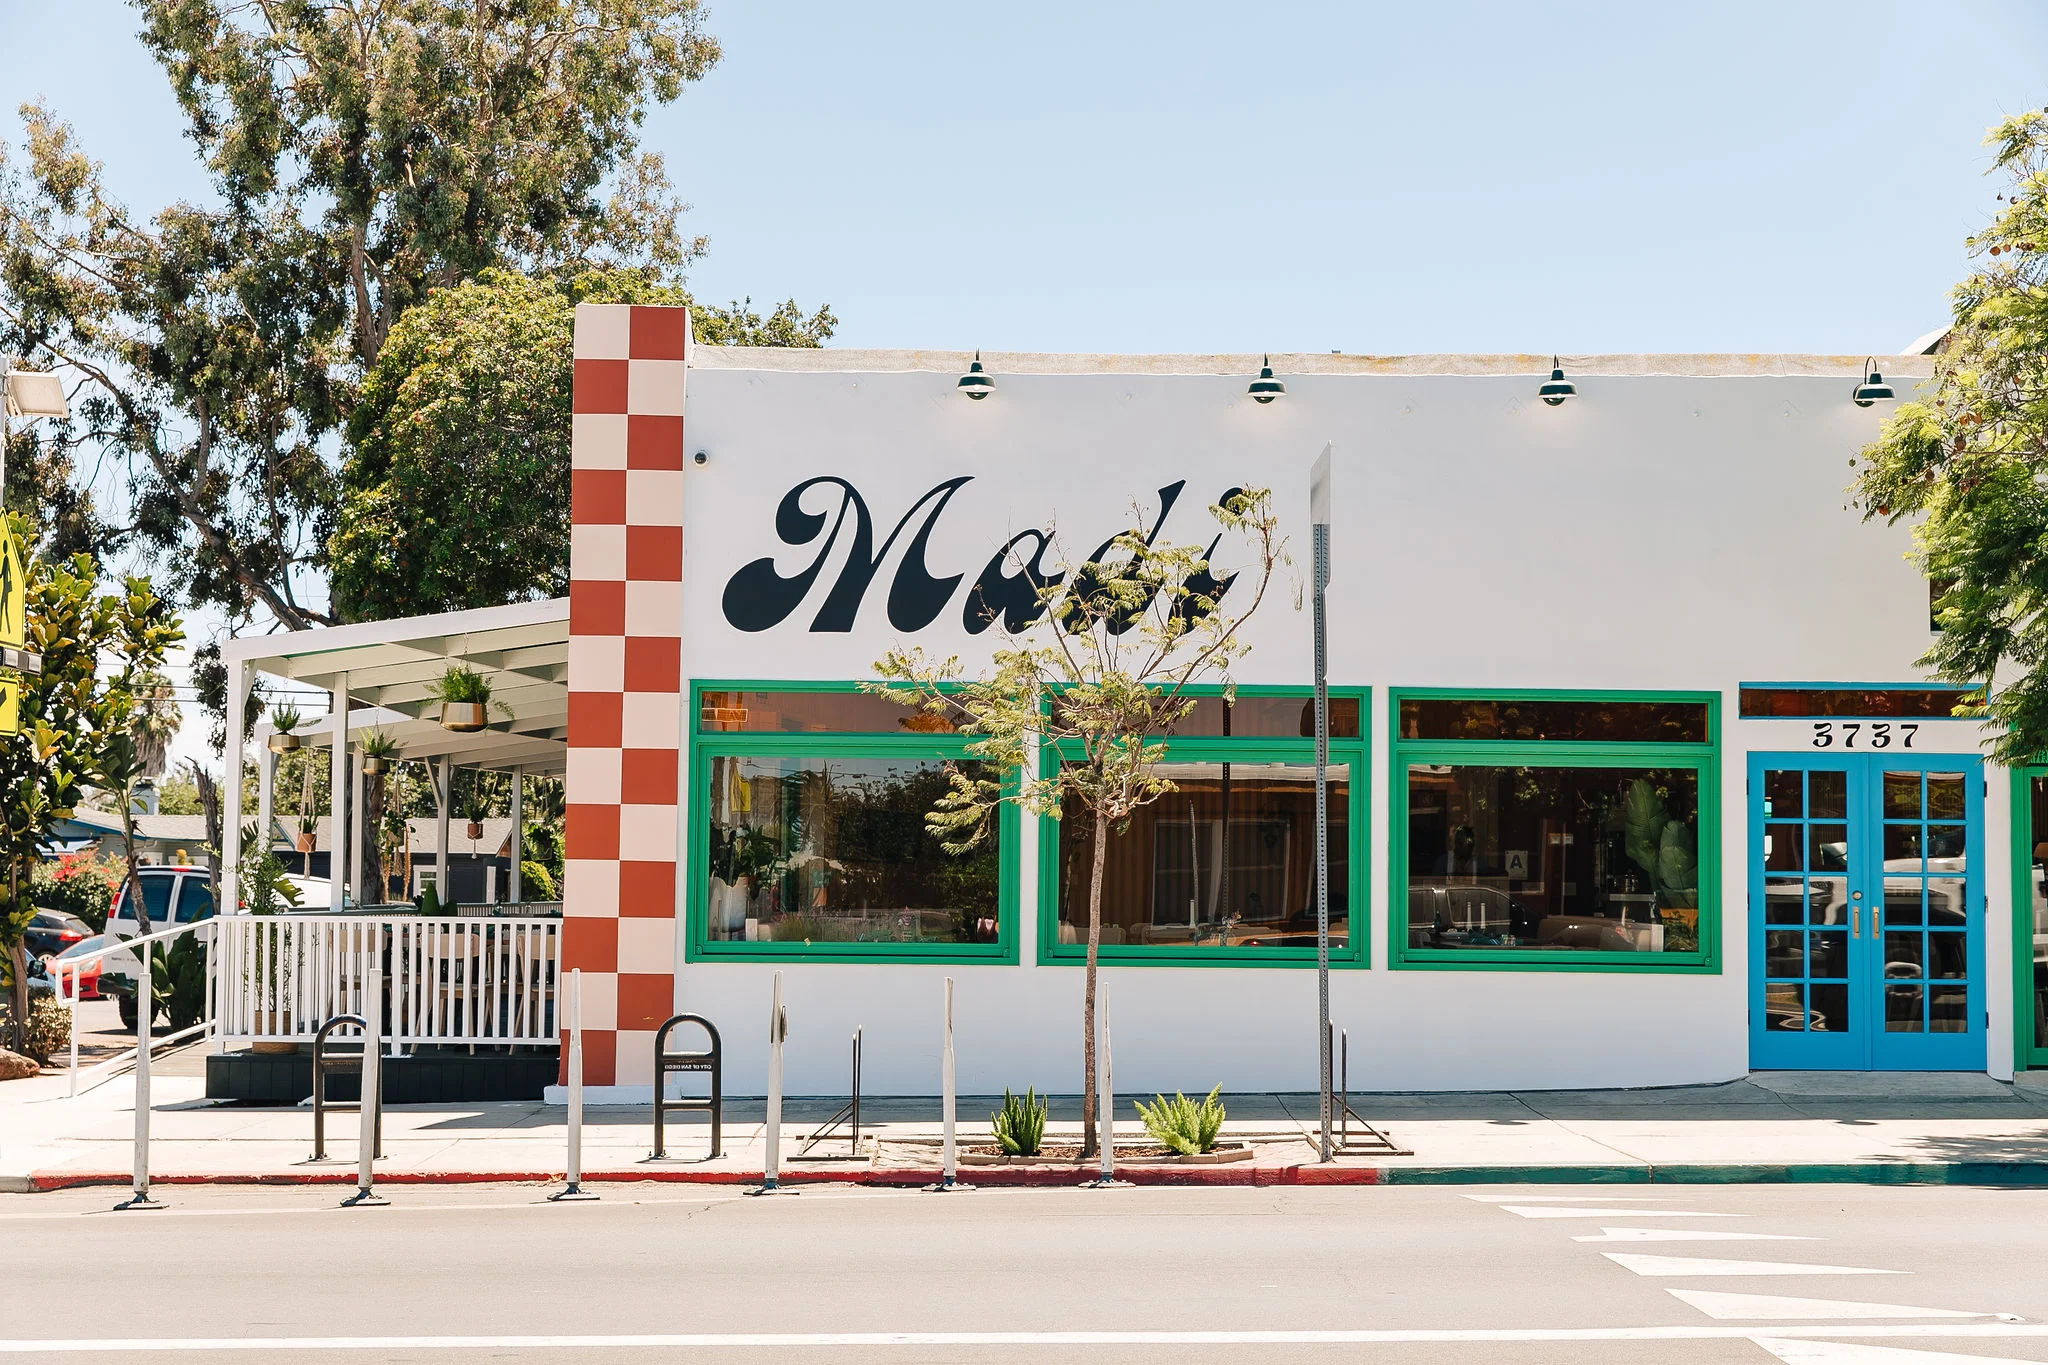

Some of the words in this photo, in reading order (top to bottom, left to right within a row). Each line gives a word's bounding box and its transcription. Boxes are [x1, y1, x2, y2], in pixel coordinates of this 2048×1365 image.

[722, 476, 1246, 635] Madi
[1812, 722, 1919, 748] 3737
[1509, 854, 1523, 869] A
